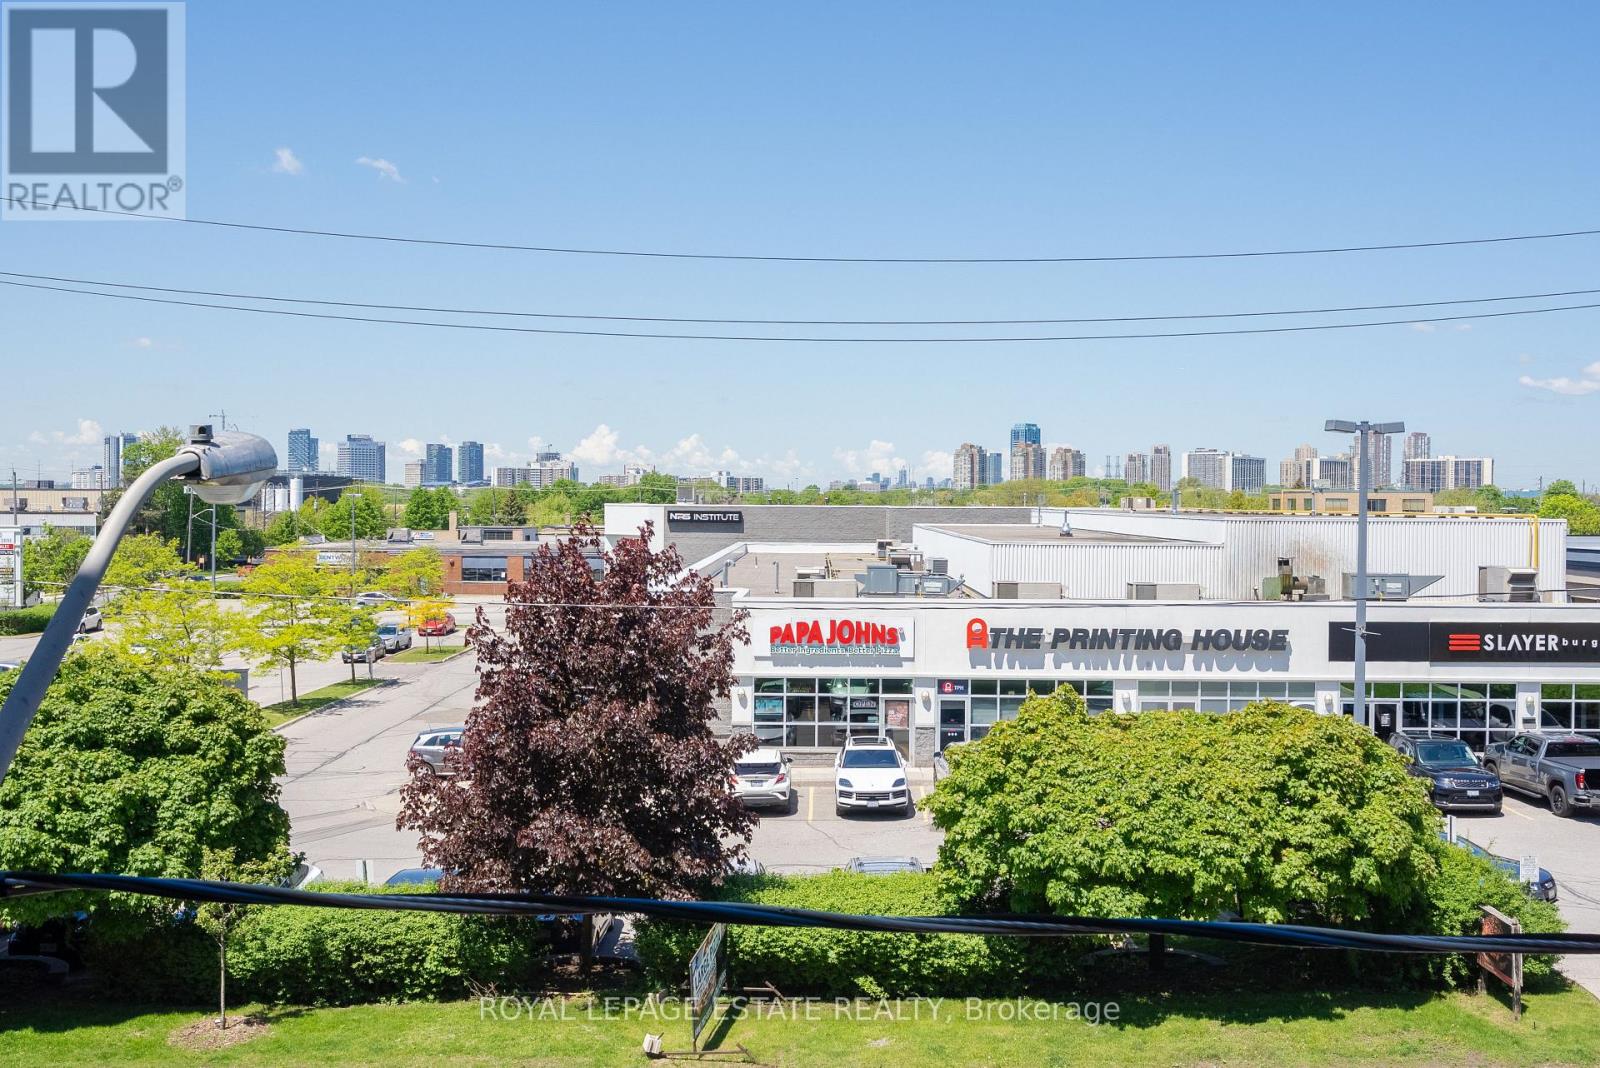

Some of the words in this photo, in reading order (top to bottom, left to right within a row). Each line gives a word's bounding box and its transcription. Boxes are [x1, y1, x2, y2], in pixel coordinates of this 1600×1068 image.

[693, 513, 740, 521] INSTITUTE
[769, 620, 825, 645] PAPA
[989, 627, 1044, 650] THE
[1051, 628, 1183, 651] PRINTING
[1191, 629, 1290, 651] HOUSE
[1483, 634, 1559, 651] SLAYER
